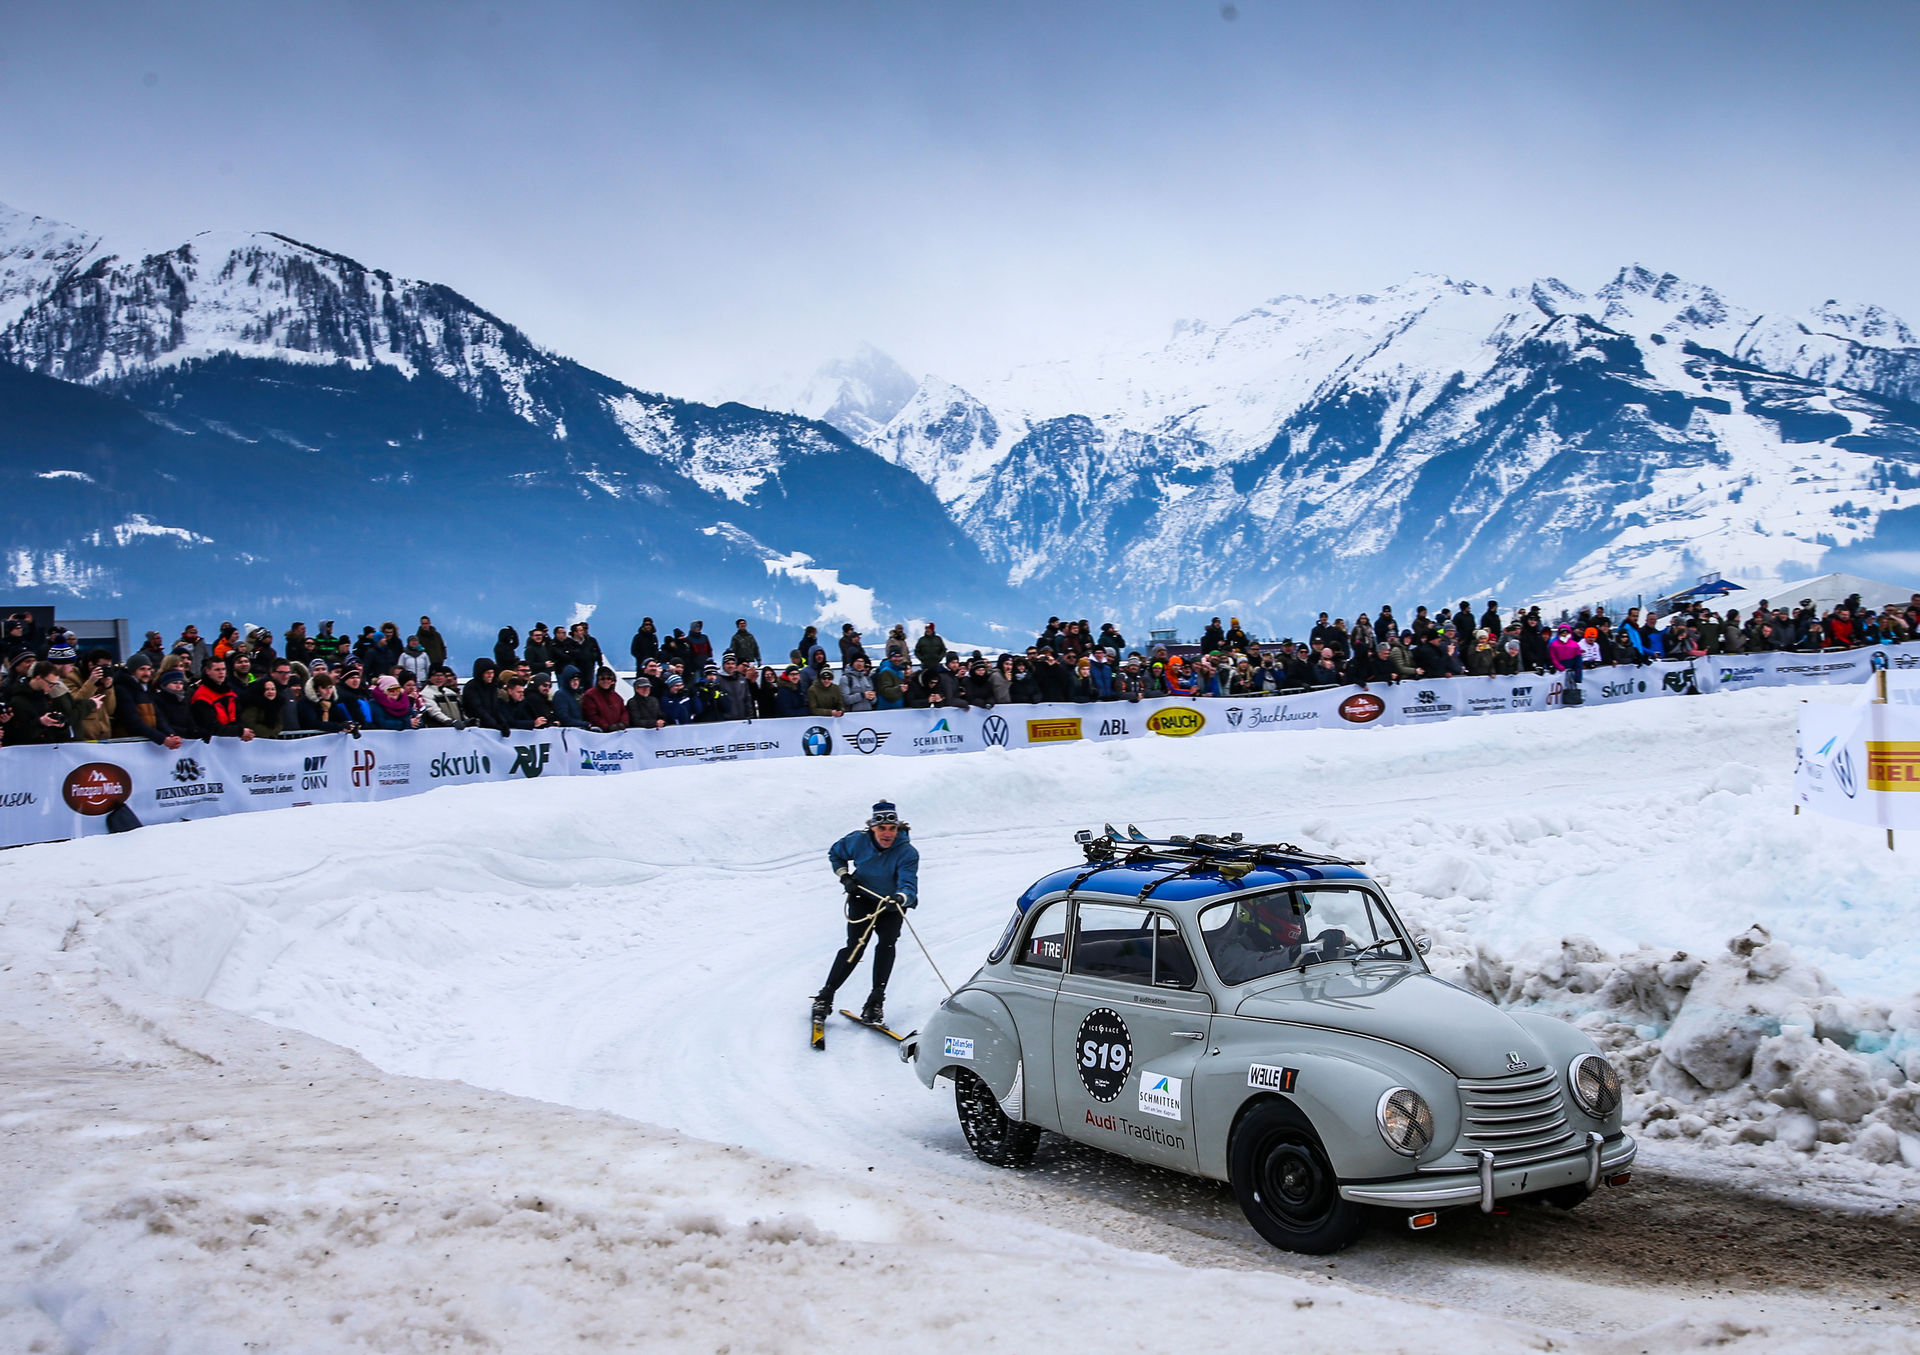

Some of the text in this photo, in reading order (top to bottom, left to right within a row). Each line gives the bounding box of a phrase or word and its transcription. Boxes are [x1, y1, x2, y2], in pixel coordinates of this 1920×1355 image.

[1601, 677, 1634, 698] skruf
[1160, 715, 1198, 730] RAUCH
[1248, 704, 1320, 729] Backhausen
[1031, 722, 1079, 738] PIRELLI
[1100, 719, 1129, 736] ABL
[859, 737, 878, 745] MINI
[913, 734, 964, 747] SCHMITTEN
[618, 749, 634, 760] See
[655, 741, 780, 759] PORSCHE DESIGN
[71, 782, 123, 799] Pinzgau Milch
[301, 775, 328, 791] OMV
[1043, 941, 1062, 959] TRE
[1081, 1040, 1127, 1072] S19
[1139, 1091, 1180, 1110] SCHMITTEN
[1085, 1109, 1185, 1150] Audi Tradition
